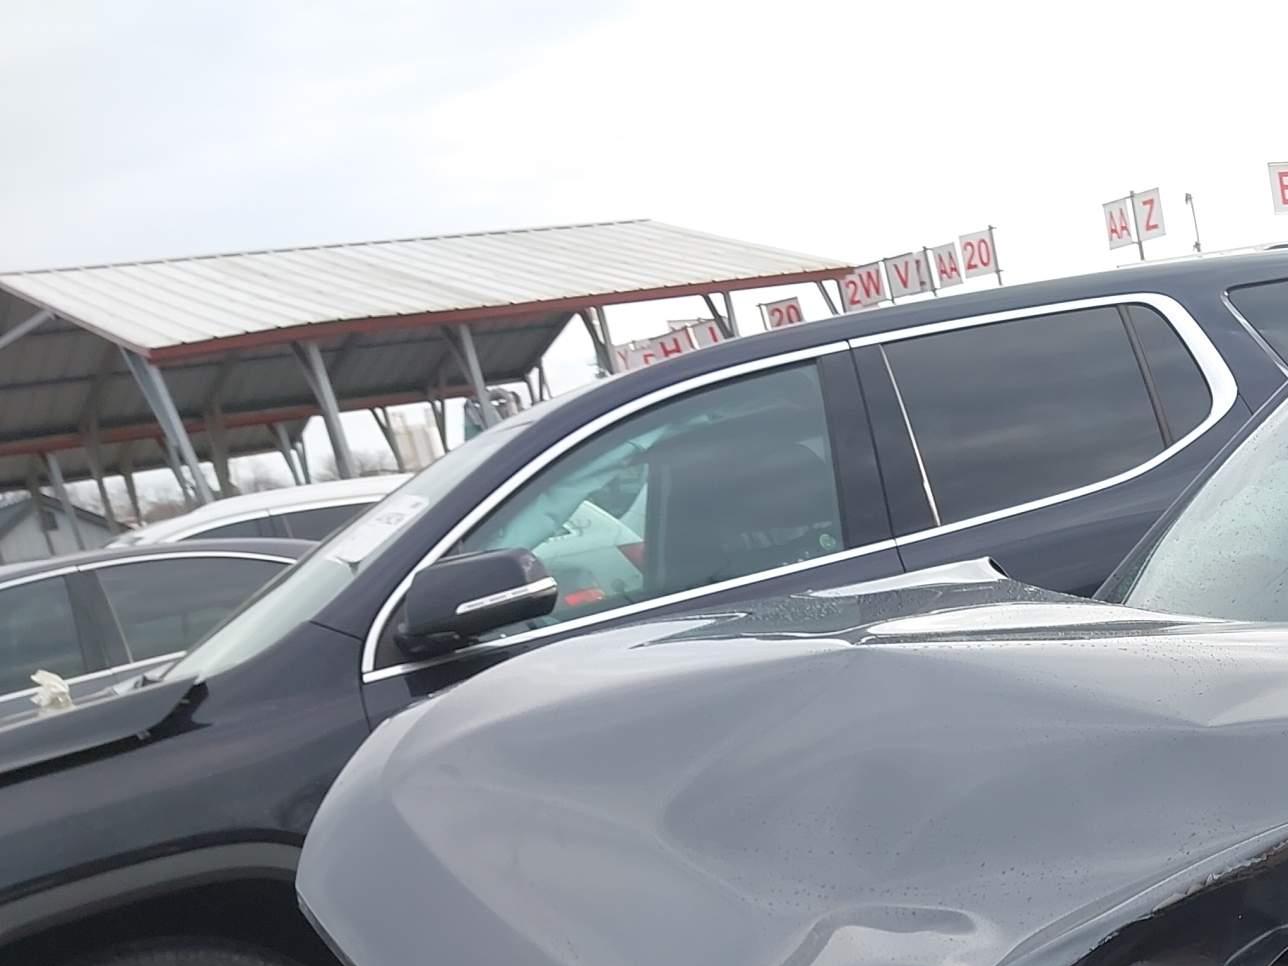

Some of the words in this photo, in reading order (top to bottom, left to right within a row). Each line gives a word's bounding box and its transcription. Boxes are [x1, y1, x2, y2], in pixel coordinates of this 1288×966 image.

[1108, 207, 1132, 241] AA
[1141, 198, 1160, 232] Z
[937, 251, 961, 280] AA
[964, 238, 991, 271] 20
[770, 303, 802, 328] 20
